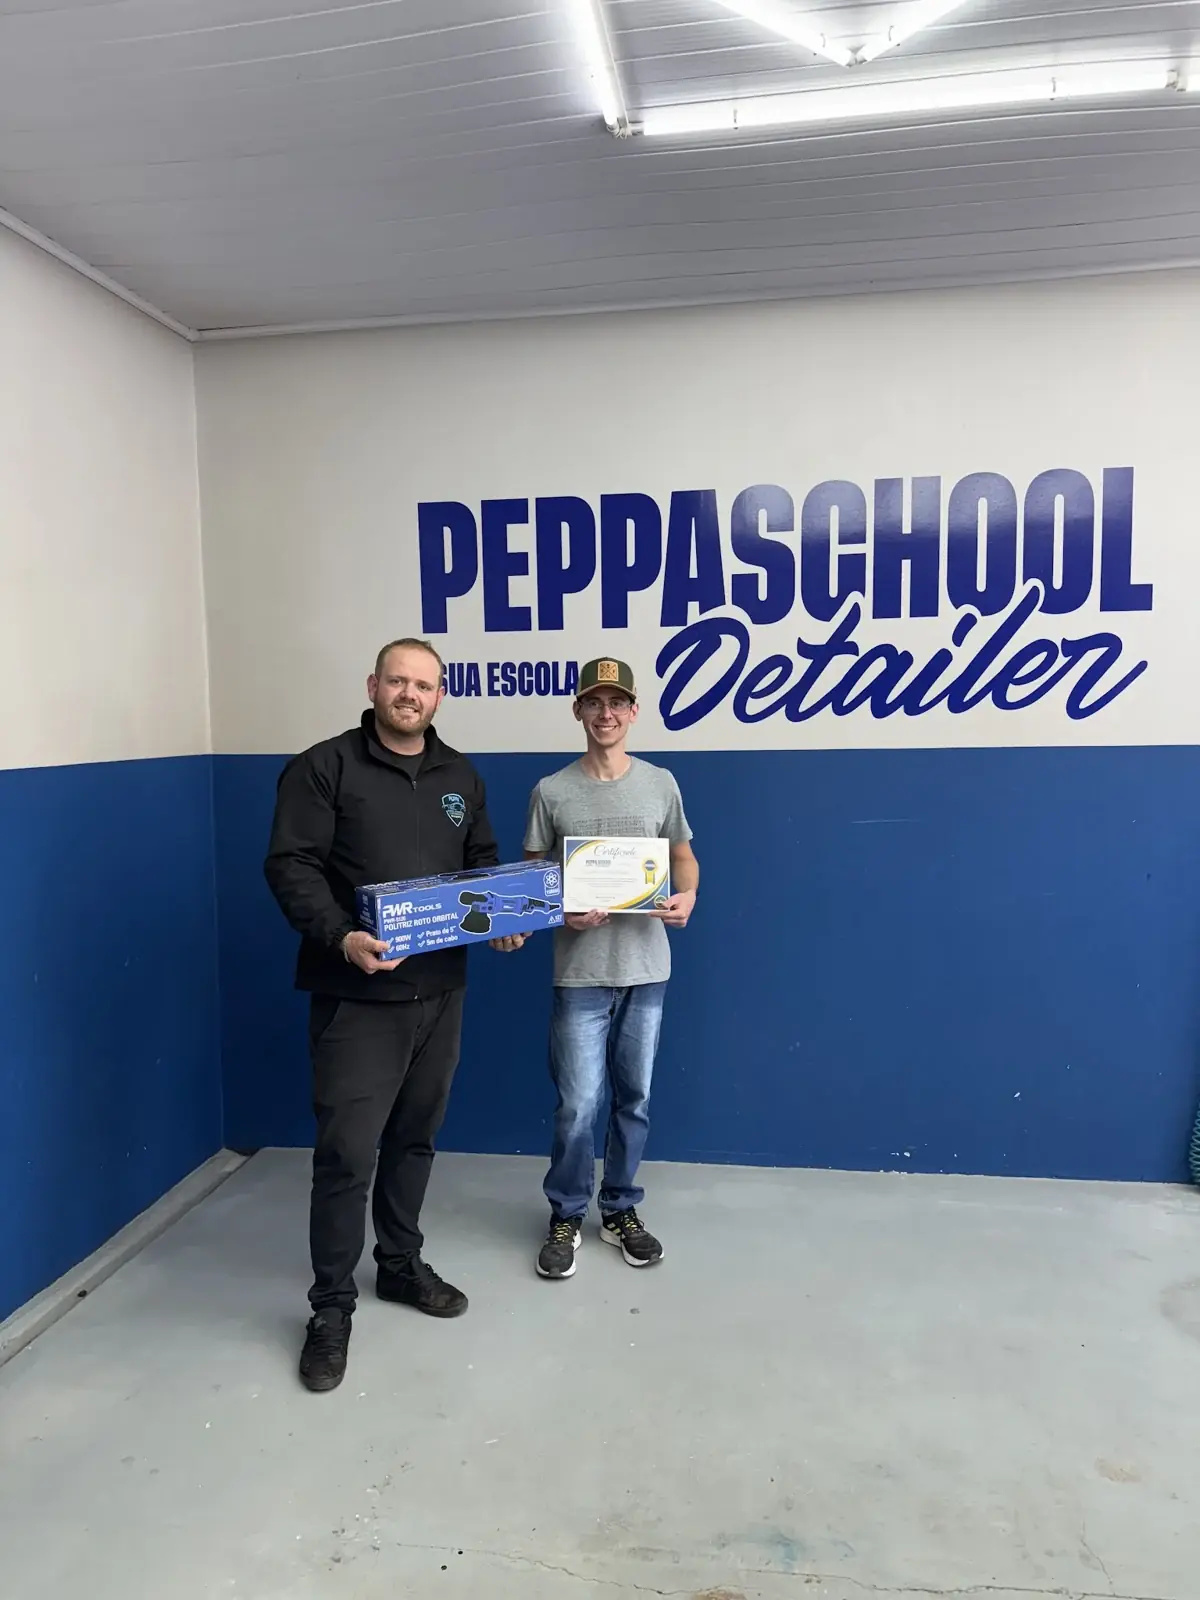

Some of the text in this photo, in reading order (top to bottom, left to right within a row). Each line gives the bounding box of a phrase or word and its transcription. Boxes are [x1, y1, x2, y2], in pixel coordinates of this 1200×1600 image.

[417, 466, 1153, 634] PEPPASCHOOL
[655, 585, 1148, 731] Detailer
[487, 661, 579, 697] ESCOLA
[382, 901, 413, 919] PWR
[413, 903, 442, 914] TOOLS
[384, 912, 459, 932] POLITRIZ ROTO ORBITAL
[395, 943, 410, 952] 60Hz
[444, 935, 459, 943] cabo
